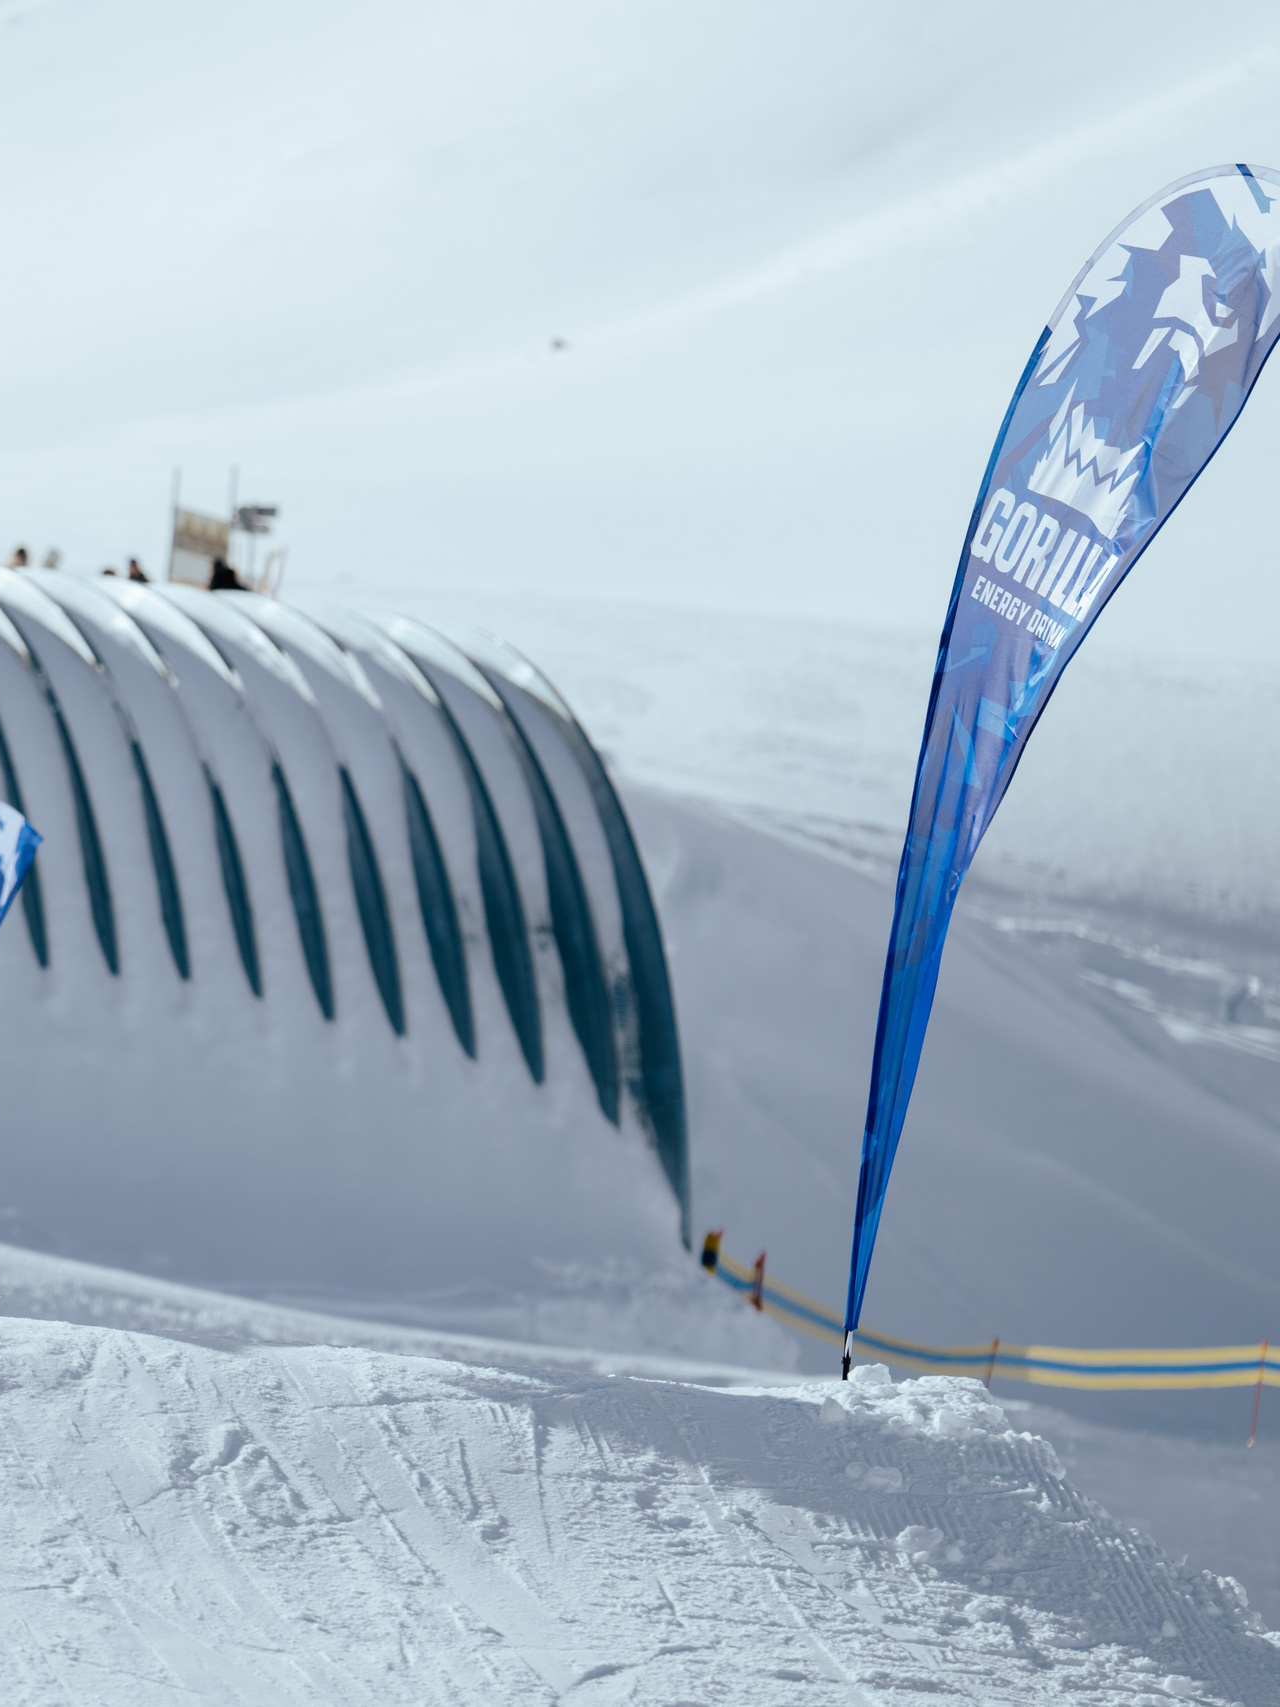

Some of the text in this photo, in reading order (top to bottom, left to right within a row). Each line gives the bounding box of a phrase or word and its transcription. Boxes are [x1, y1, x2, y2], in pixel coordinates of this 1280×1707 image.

[971, 489, 1119, 622] GORILLA
[972, 576, 1067, 650] ENERGY DRINK
